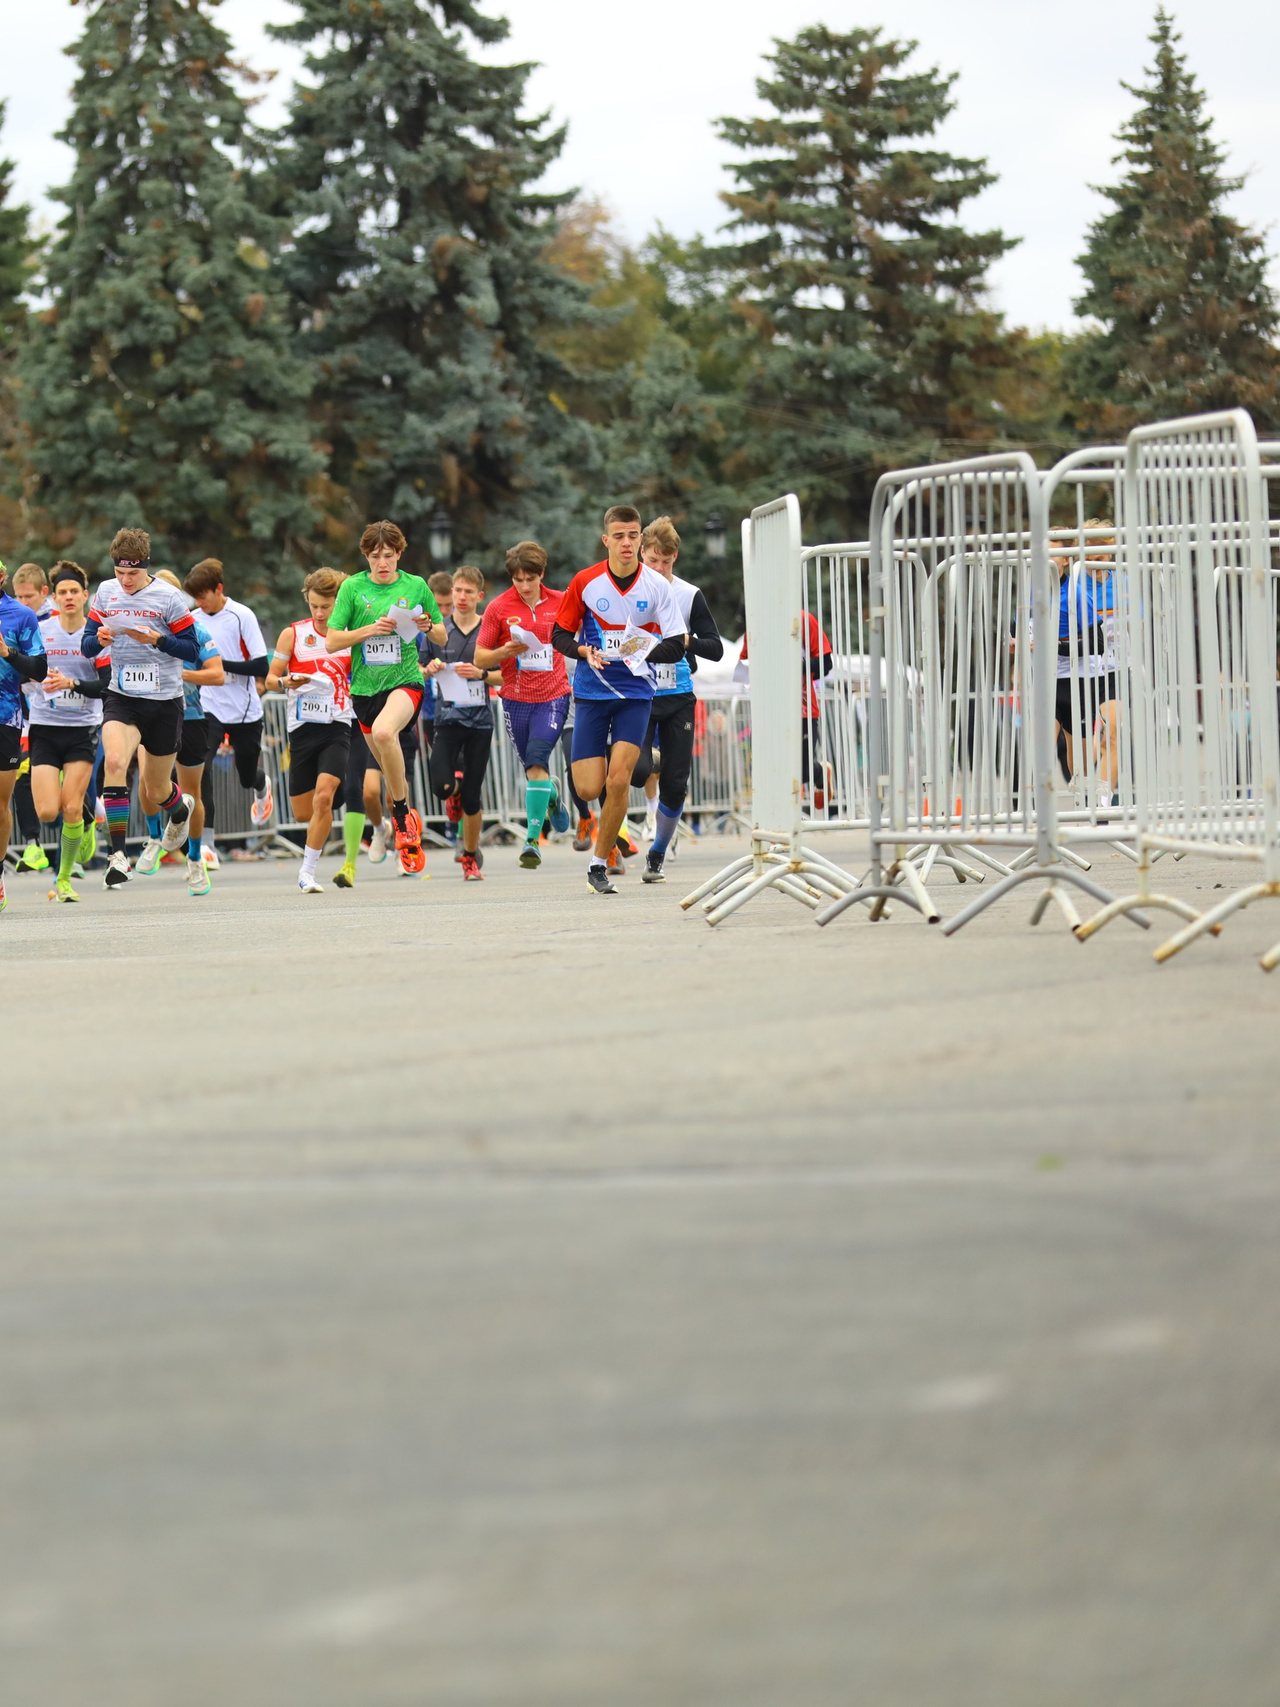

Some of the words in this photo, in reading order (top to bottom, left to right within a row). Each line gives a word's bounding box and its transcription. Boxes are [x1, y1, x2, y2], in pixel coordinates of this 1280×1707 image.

[133, 610, 162, 618] WEST
[366, 643, 394, 653] 207.1
[124, 671, 153, 682] 210.1
[302, 701, 328, 713] 209.1
